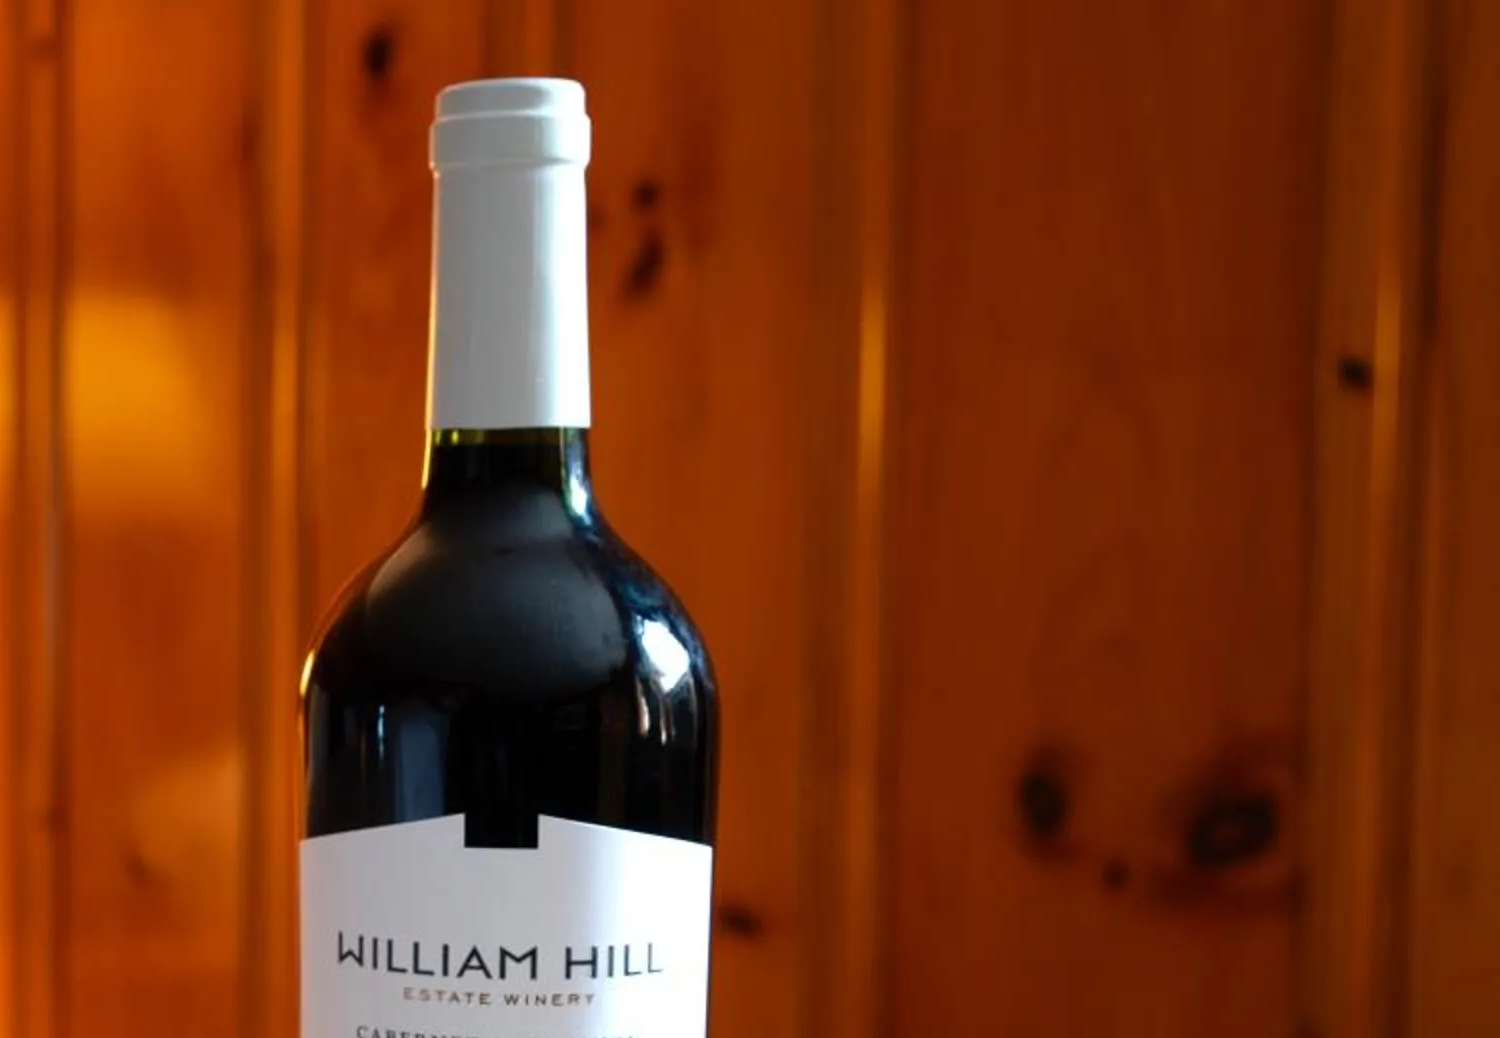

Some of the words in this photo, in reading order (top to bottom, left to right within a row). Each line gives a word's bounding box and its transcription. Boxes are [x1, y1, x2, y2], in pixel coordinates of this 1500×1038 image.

[337, 931, 538, 980] WILLIAM
[565, 942, 664, 979] HILL
[403, 987, 492, 1005] ESTATE
[504, 993, 595, 1006] WINERY
